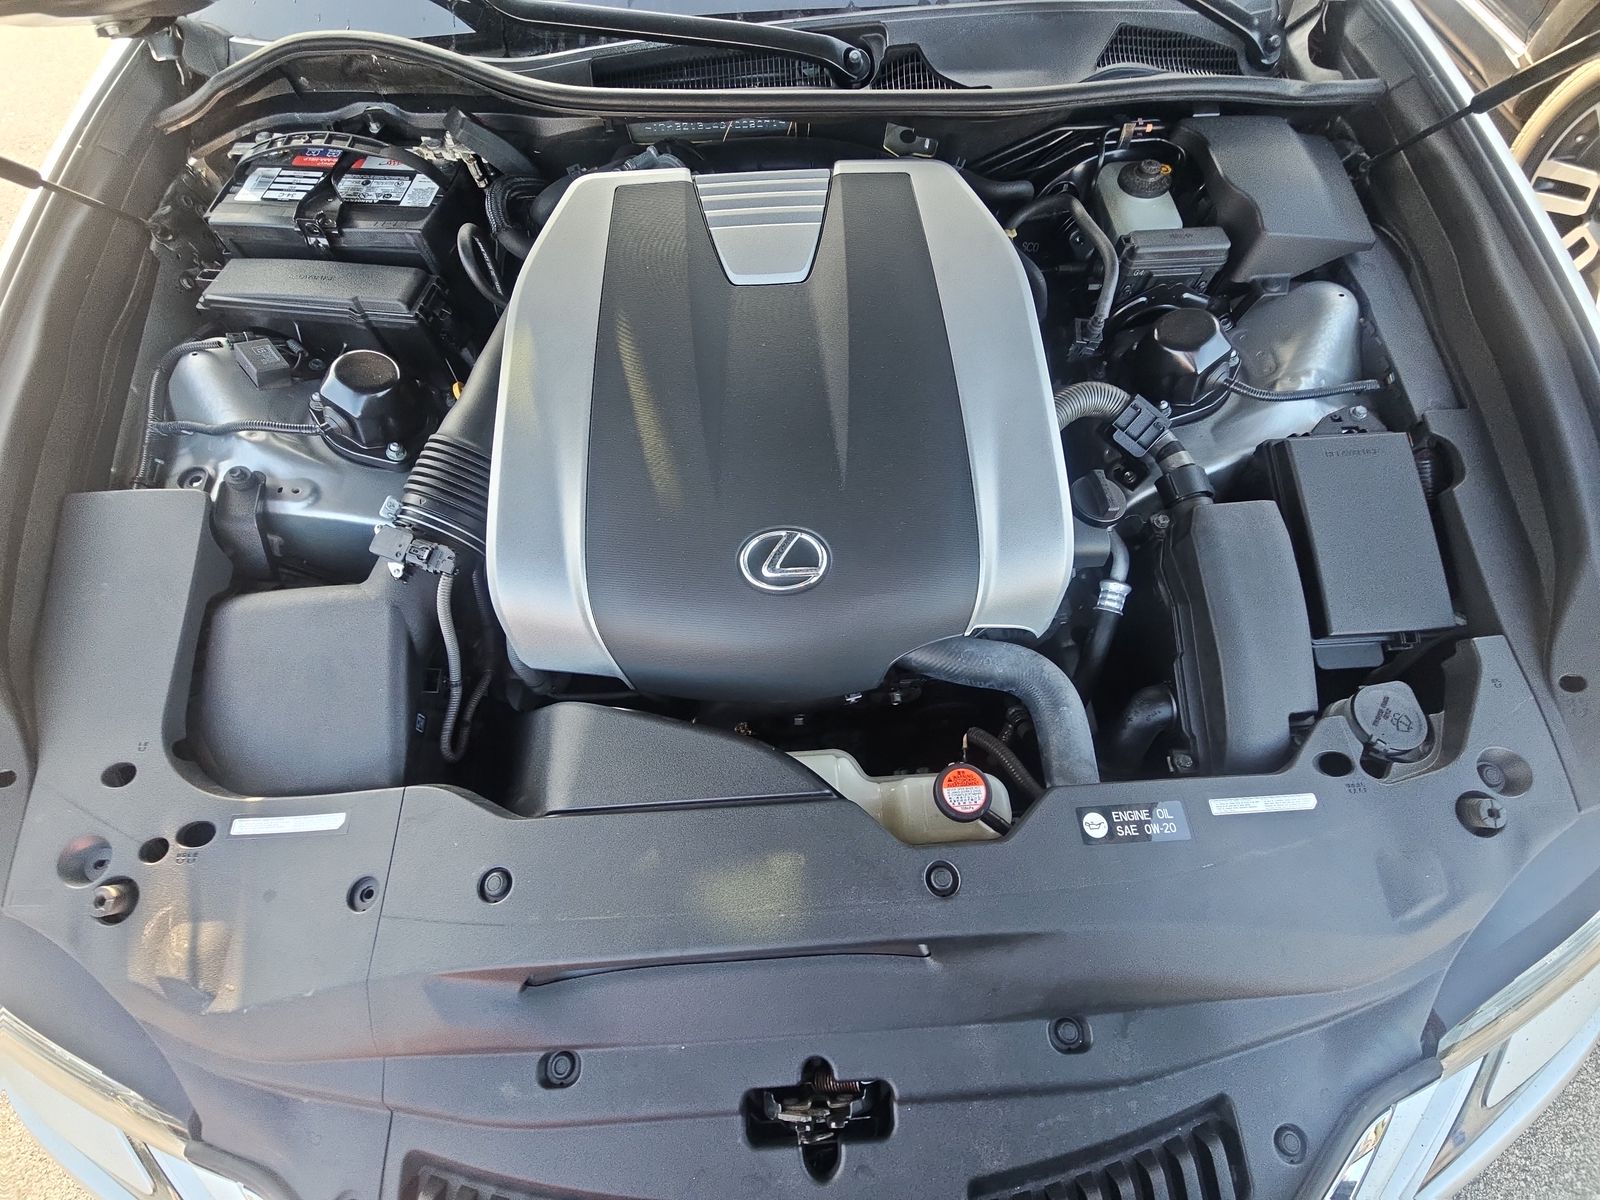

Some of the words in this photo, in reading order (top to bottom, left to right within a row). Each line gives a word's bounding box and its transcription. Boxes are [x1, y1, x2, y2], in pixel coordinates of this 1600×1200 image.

[1111, 808, 1152, 823] ENGINE
[1156, 807, 1174, 820] OIL
[1116, 823, 1139, 837] SAE
[1144, 822, 1177, 836] 0W-20
